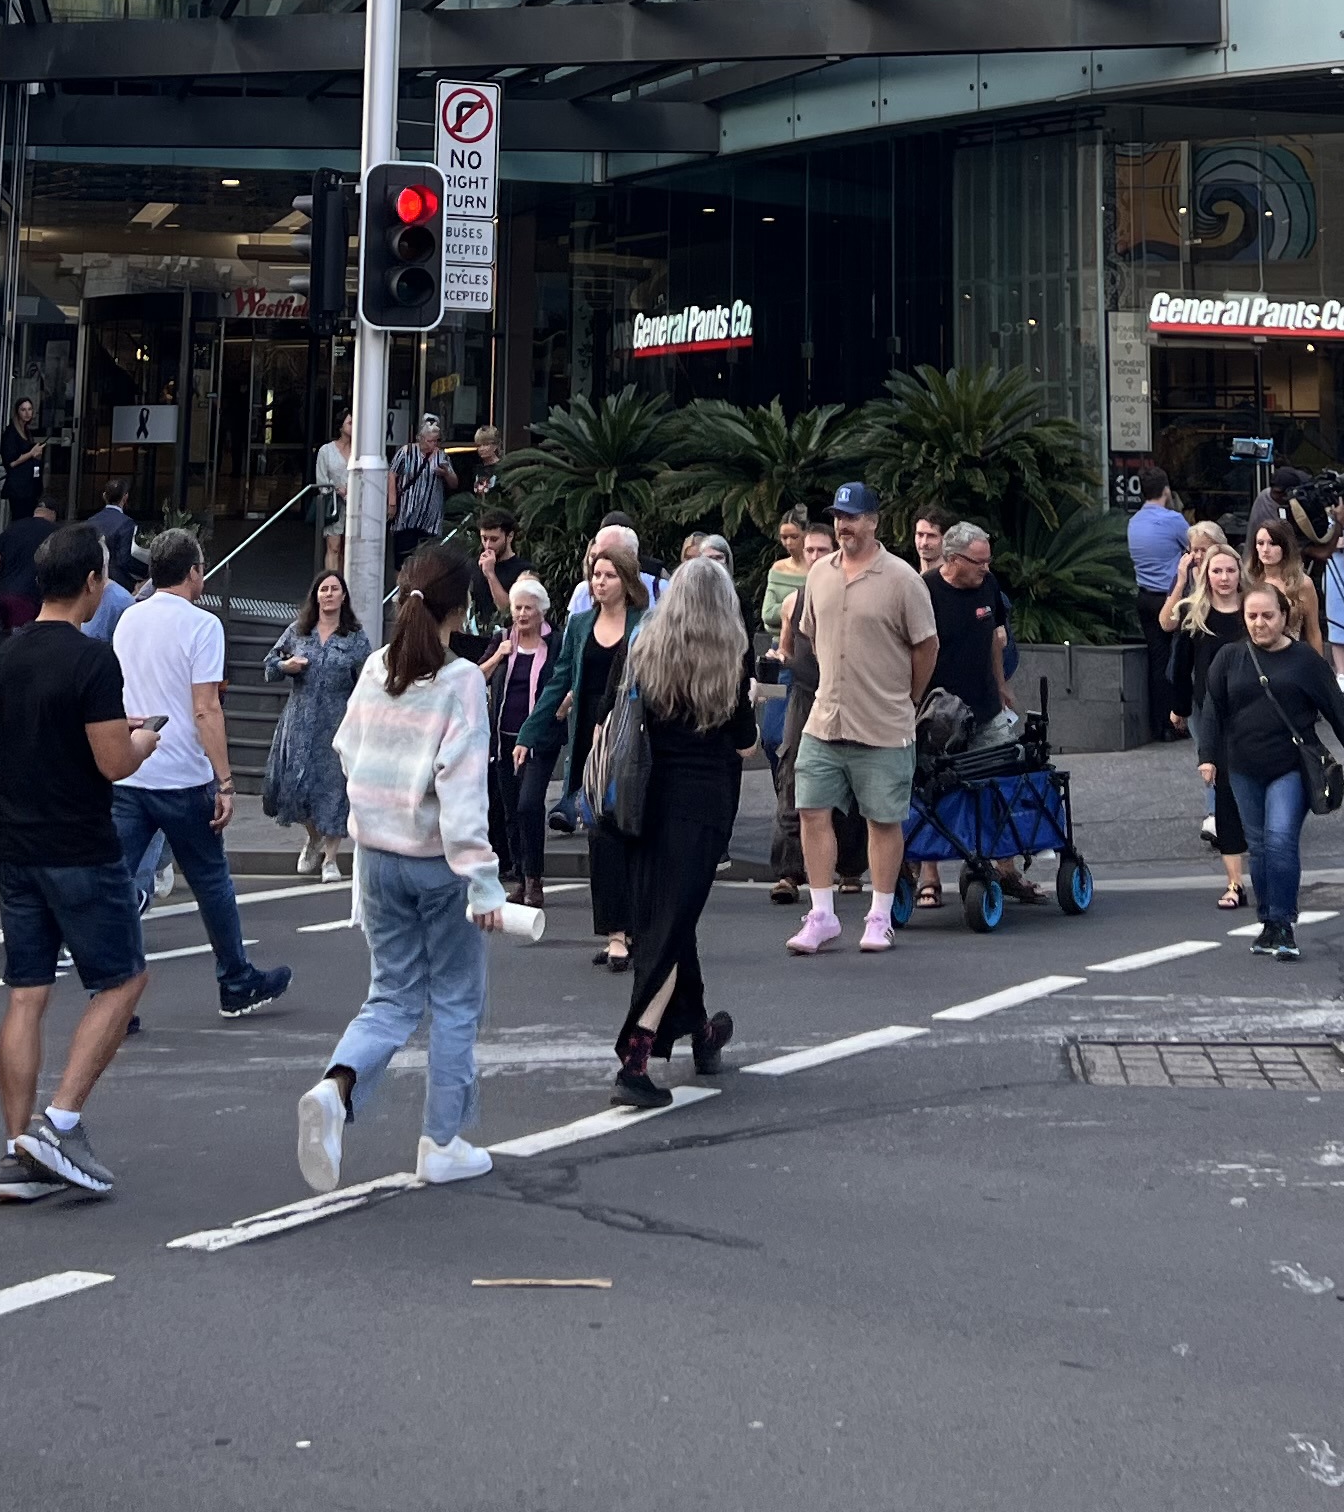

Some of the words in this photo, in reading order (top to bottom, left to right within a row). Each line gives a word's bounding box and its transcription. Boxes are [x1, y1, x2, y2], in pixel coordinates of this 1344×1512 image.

[450, 148, 482, 170] NO
[446, 174, 489, 190] RIGHT
[446, 194, 487, 209] TURN
[445, 226, 483, 239] BUSES
[445, 243, 488, 256] XCEPTED
[445, 271, 489, 285] ICYCLES
[233, 286, 310, 318] Westfiel
[444, 290, 489, 303] XCEPTED
[1150, 292, 1249, 326] General
[1247, 297, 1320, 330] Pants
[632, 306, 690, 350] General
[688, 305, 731, 343] Pants
[730, 299, 753, 338] Co.
[1113, 360, 1145, 368] WOMENS
[1118, 367, 1141, 375] DENIM
[1121, 429, 1141, 438] GEAR
